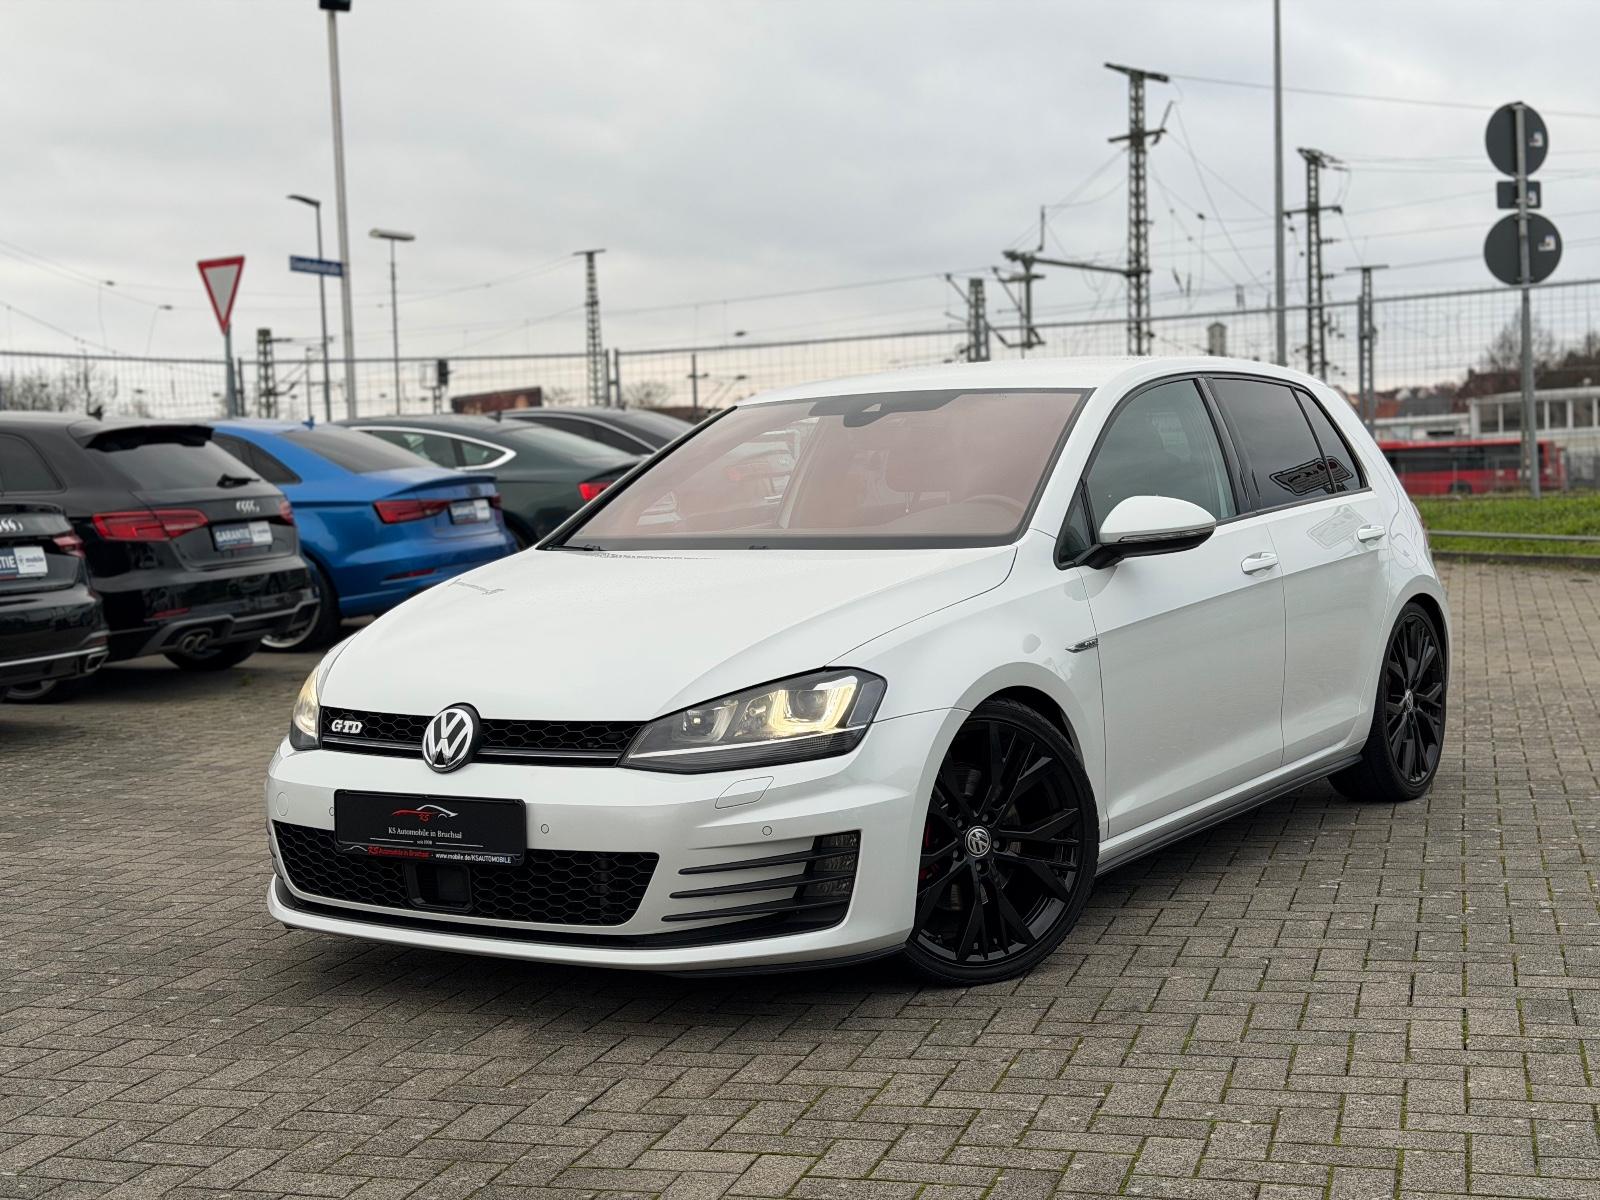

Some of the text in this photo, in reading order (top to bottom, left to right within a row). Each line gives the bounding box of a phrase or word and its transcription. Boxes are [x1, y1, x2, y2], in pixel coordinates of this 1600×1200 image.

[215, 527, 250, 541] GARANTIE
[0, 555, 16, 568] TIE
[331, 719, 363, 734] GTD
[388, 826, 463, 839] KS Automobile in Bruchsal
[435, 853, 512, 864] www.mobile.de/KSAUTOMOBILE
